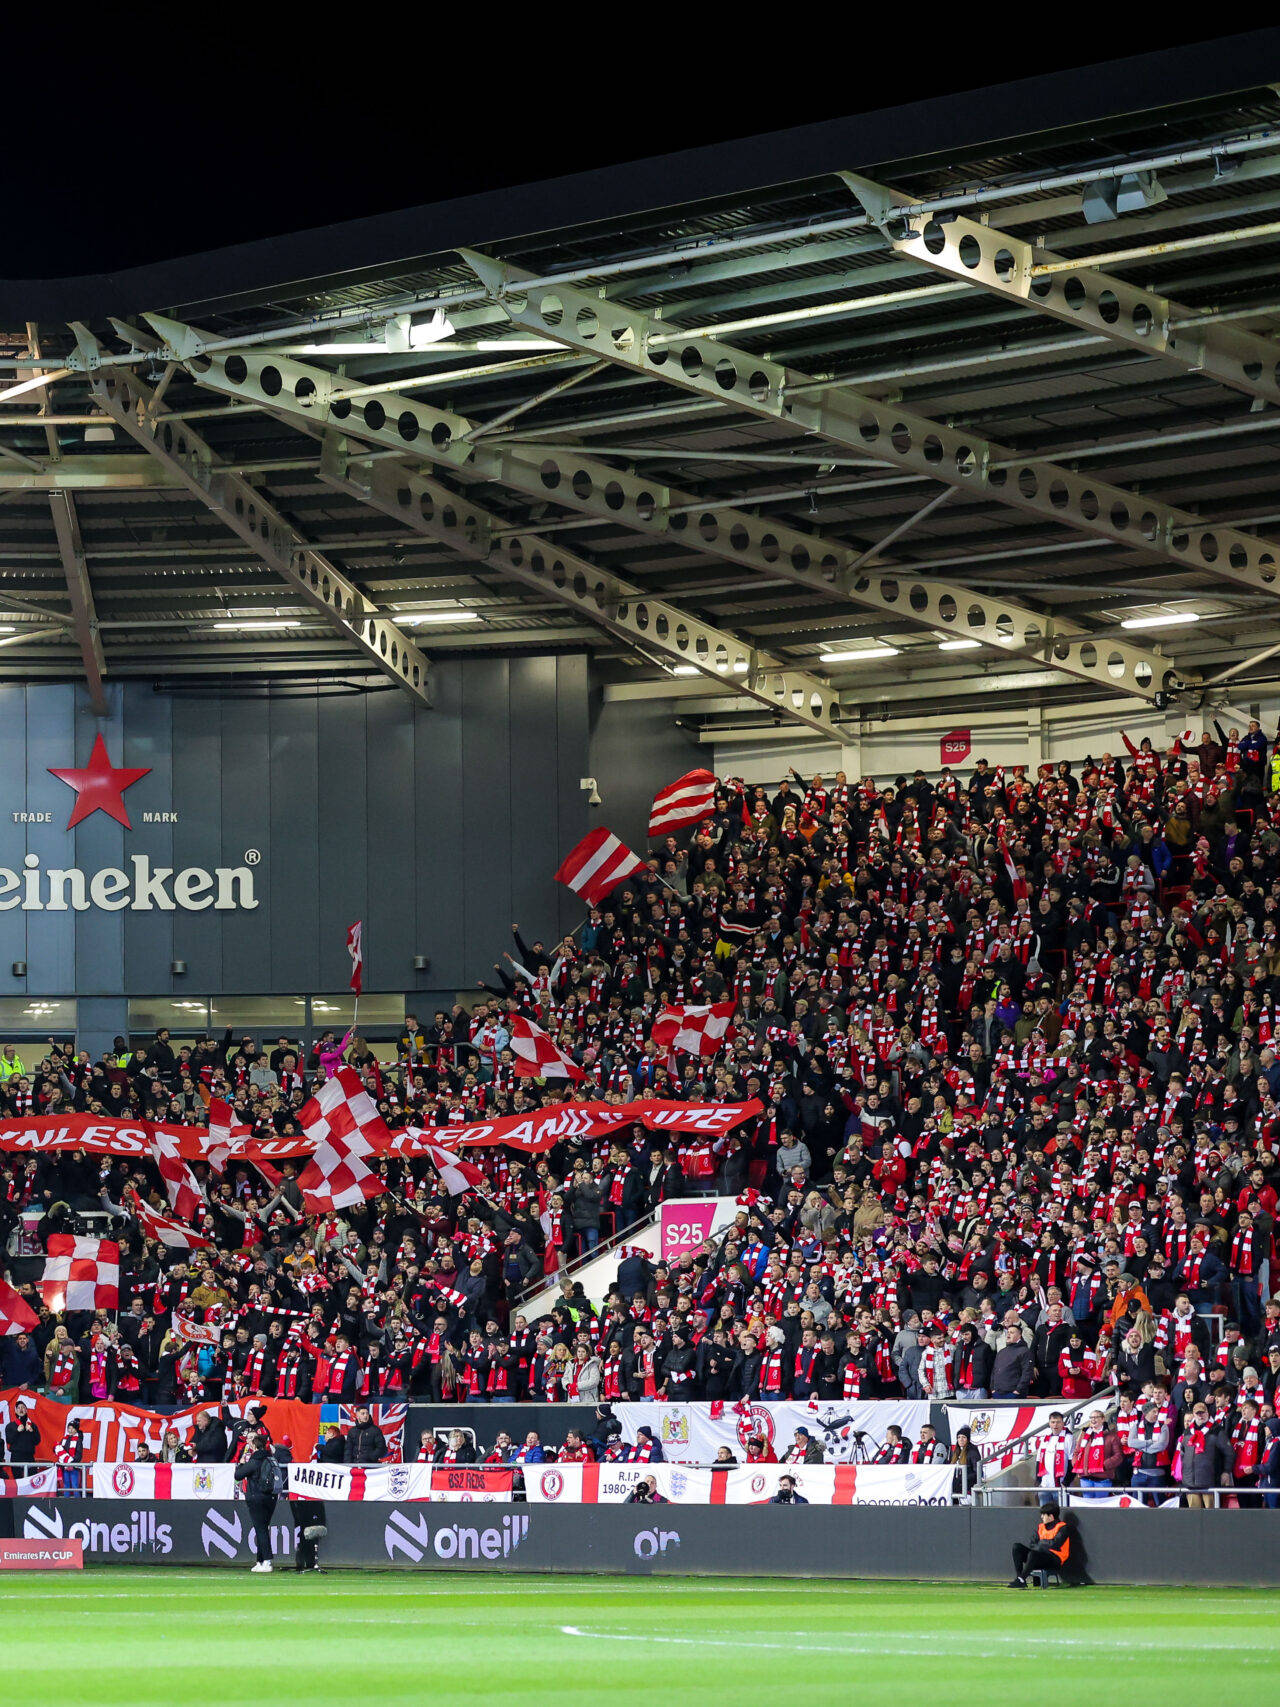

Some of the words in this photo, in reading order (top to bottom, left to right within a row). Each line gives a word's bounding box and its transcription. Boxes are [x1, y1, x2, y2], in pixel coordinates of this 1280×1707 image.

[945, 741, 967, 753] S25
[12, 812, 52, 823] TRADE
[143, 812, 178, 823] MARK
[498, 1108, 594, 1144] AND
[665, 1223, 704, 1247] S25
[294, 1466, 345, 1490] JARRETT
[448, 1472, 464, 1489] BS2
[466, 1472, 486, 1489] REDS
[3, 1551, 38, 1560] Emirates
[39, 1551, 51, 1560] FA
[52, 1551, 73, 1560] CUP
